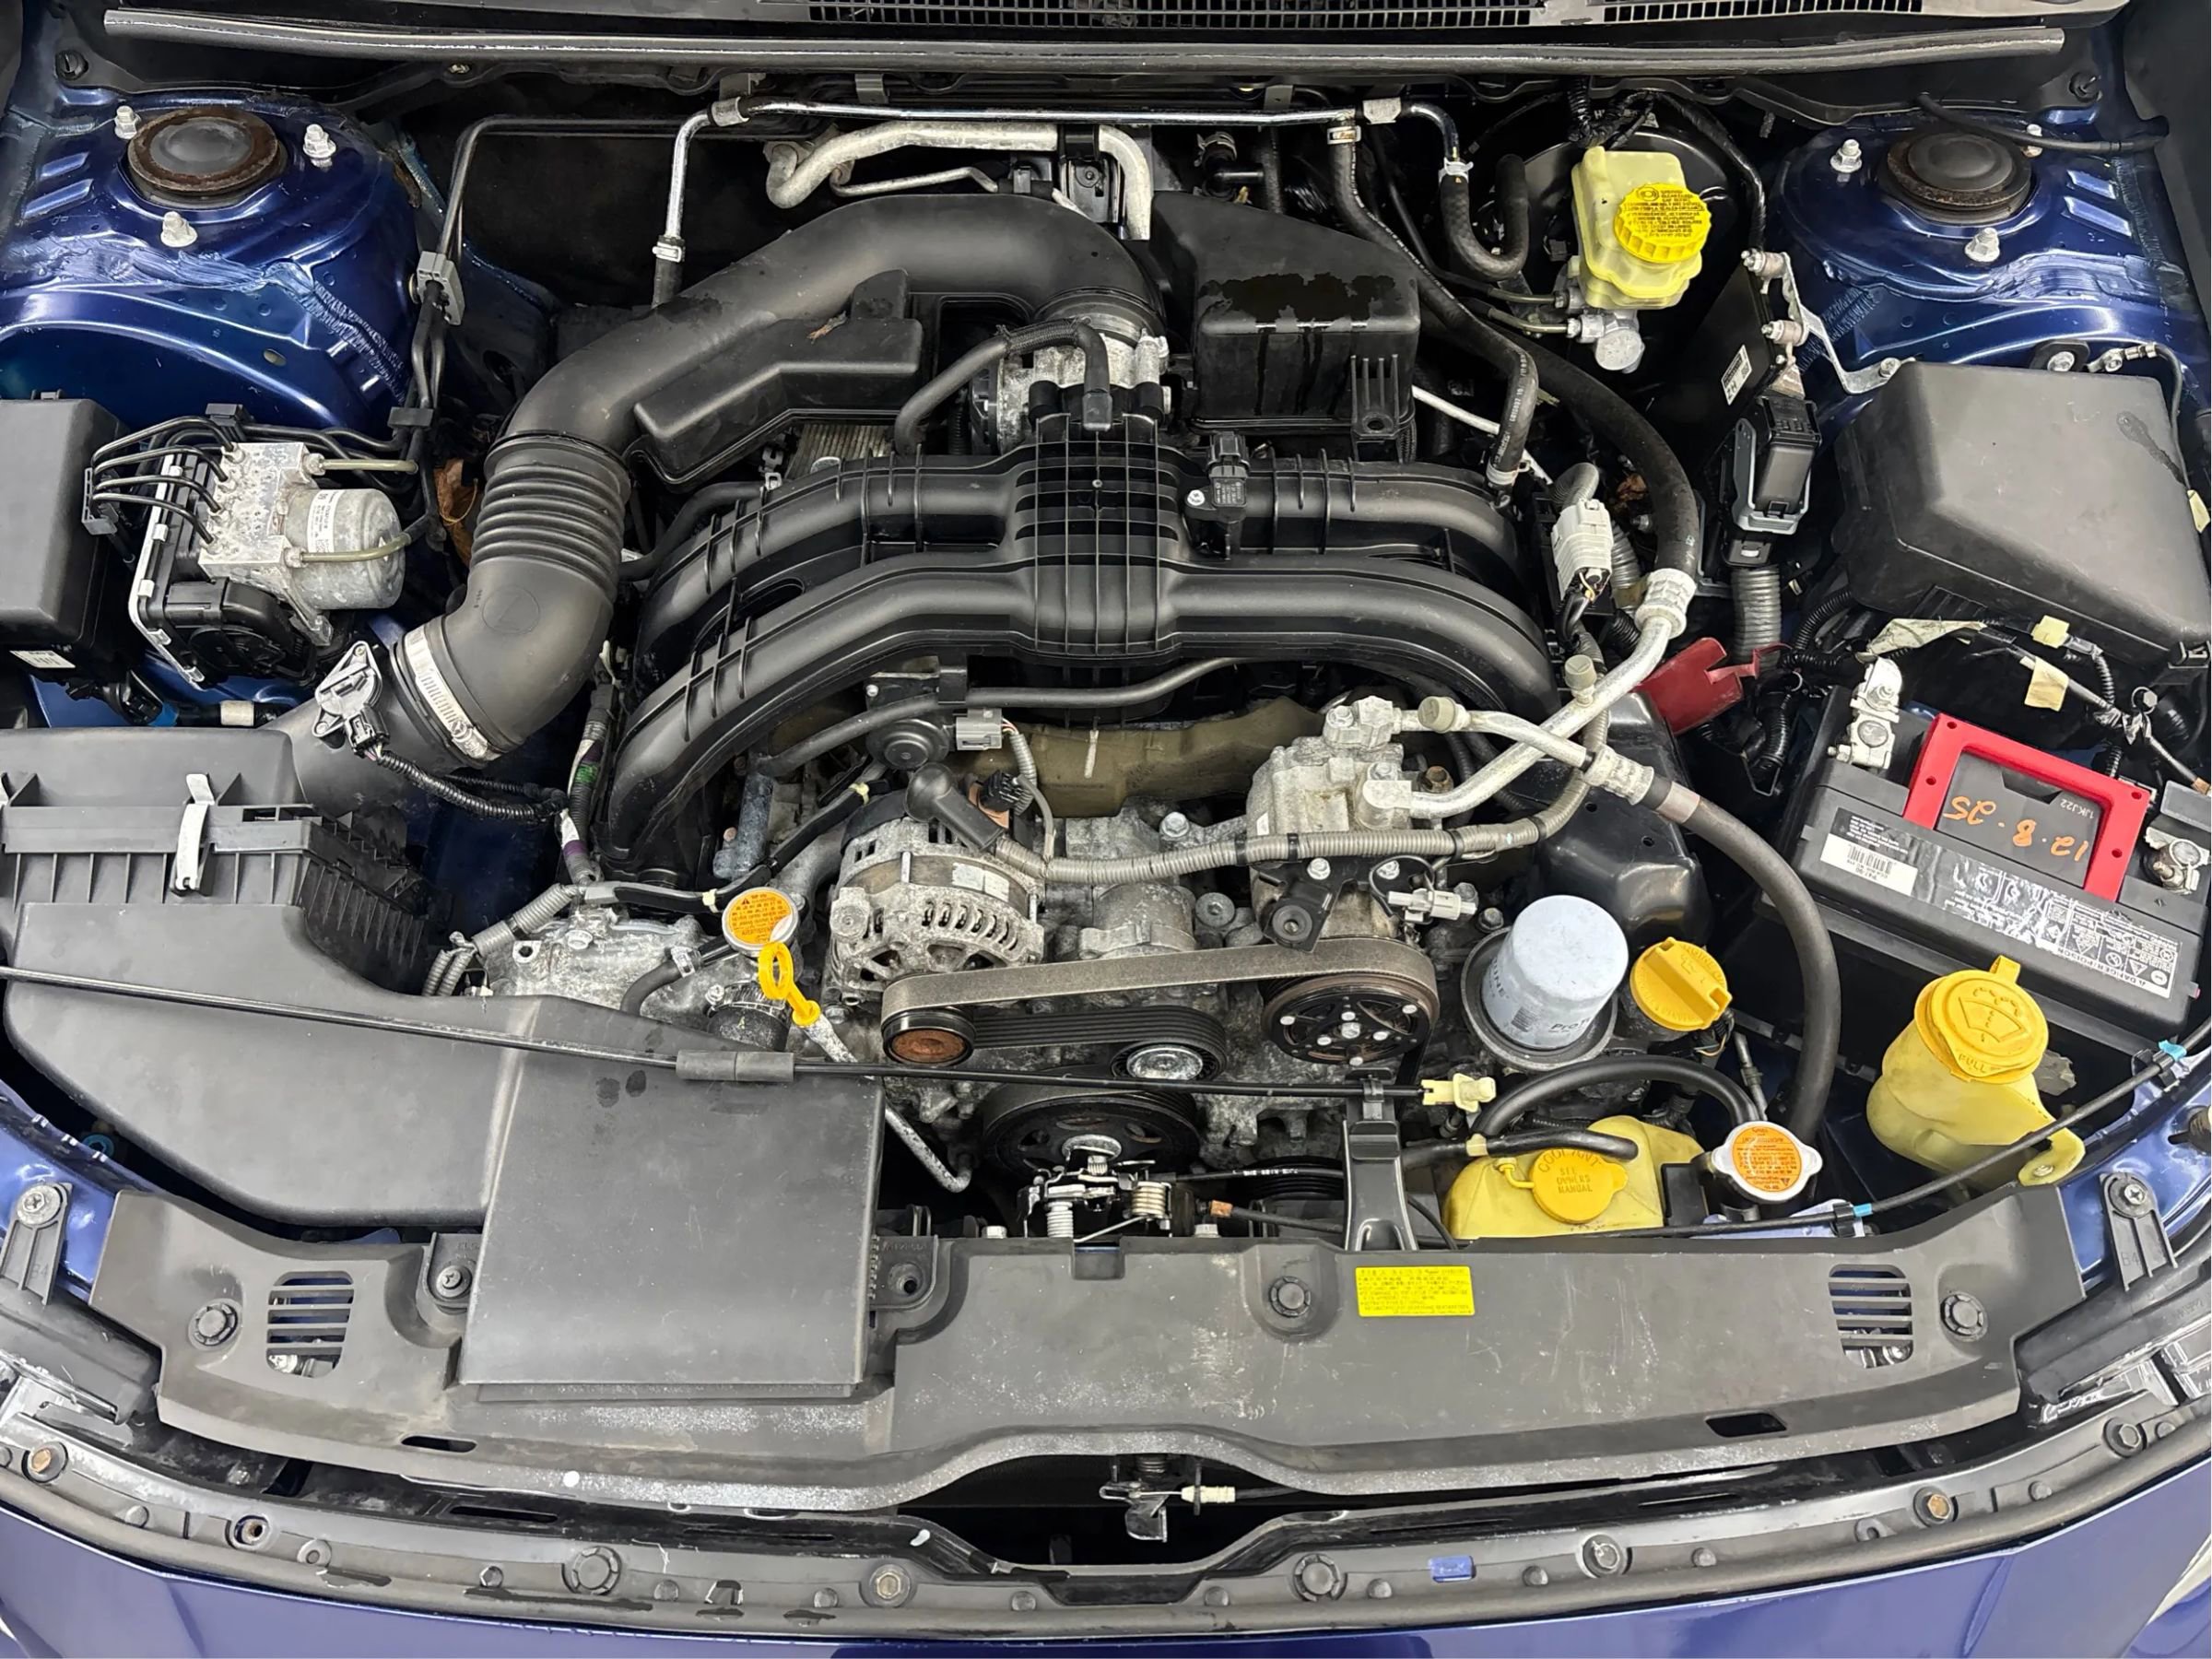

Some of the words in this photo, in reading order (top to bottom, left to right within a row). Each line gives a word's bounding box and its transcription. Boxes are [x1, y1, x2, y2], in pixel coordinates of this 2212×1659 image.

[2060, 798, 2095, 820] 1JKJ22
[1959, 1053, 1987, 1074] PULL
[1558, 1185, 1593, 1194] MANUAL
